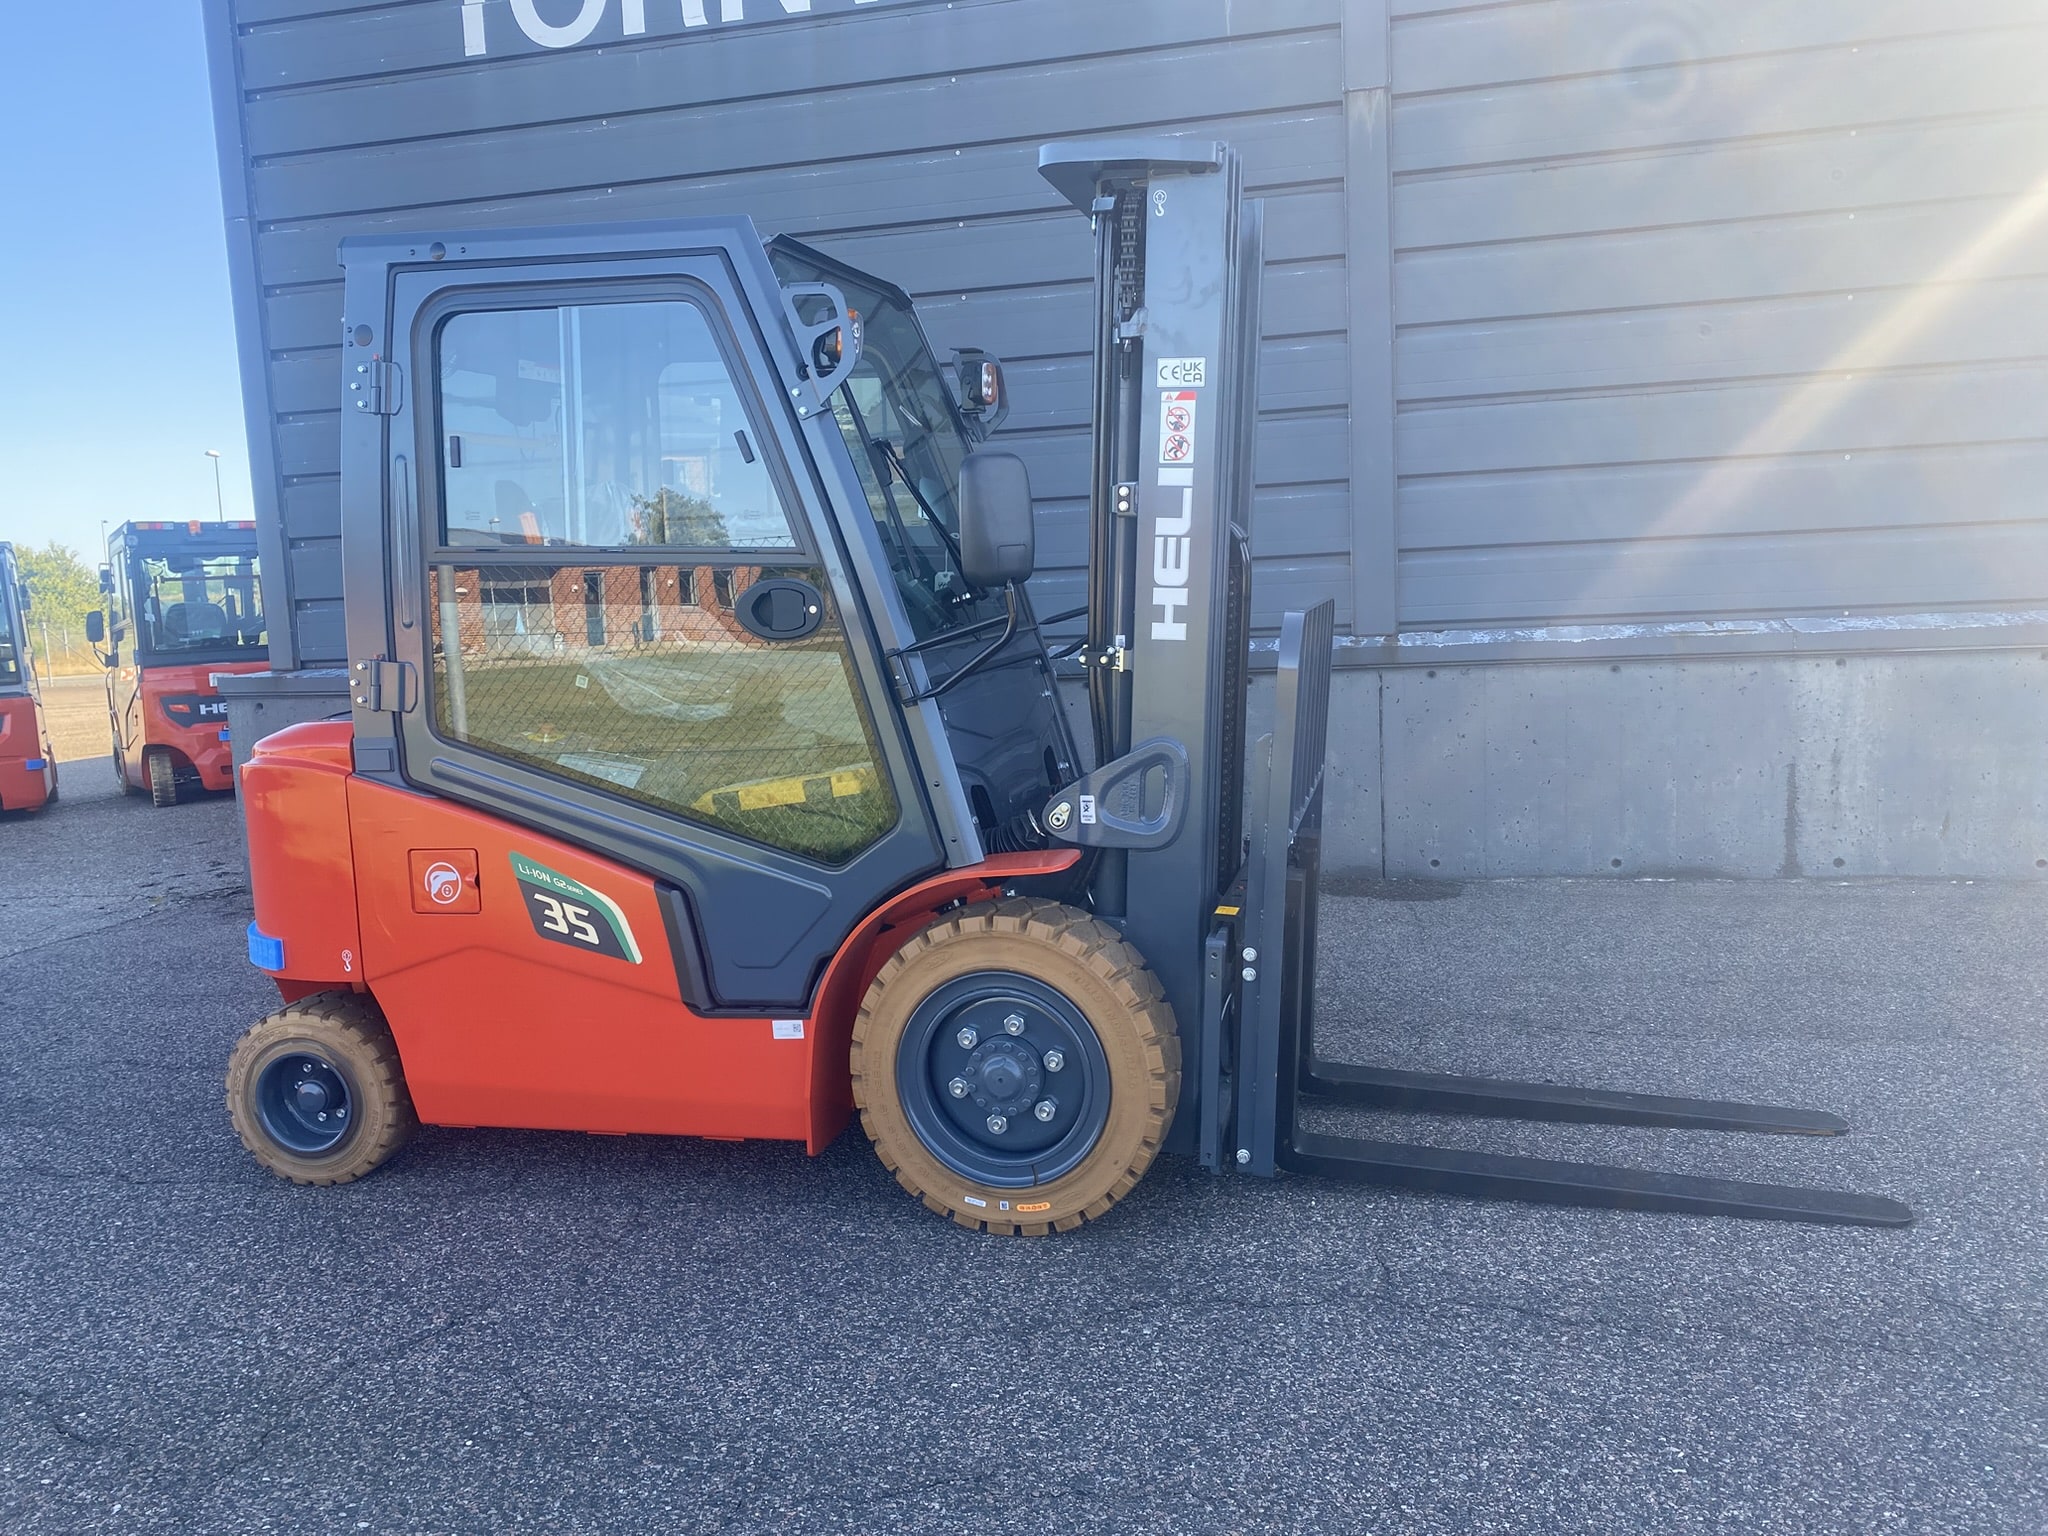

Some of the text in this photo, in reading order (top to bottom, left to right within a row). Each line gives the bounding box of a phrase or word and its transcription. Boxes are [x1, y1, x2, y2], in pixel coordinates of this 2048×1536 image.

[1159, 365, 1180, 380] CE
[1183, 361, 1202, 372] UK
[1182, 372, 1203, 383] CA
[1151, 467, 1194, 641] HELI
[553, 878, 566, 889] G2
[533, 893, 600, 945] 35
